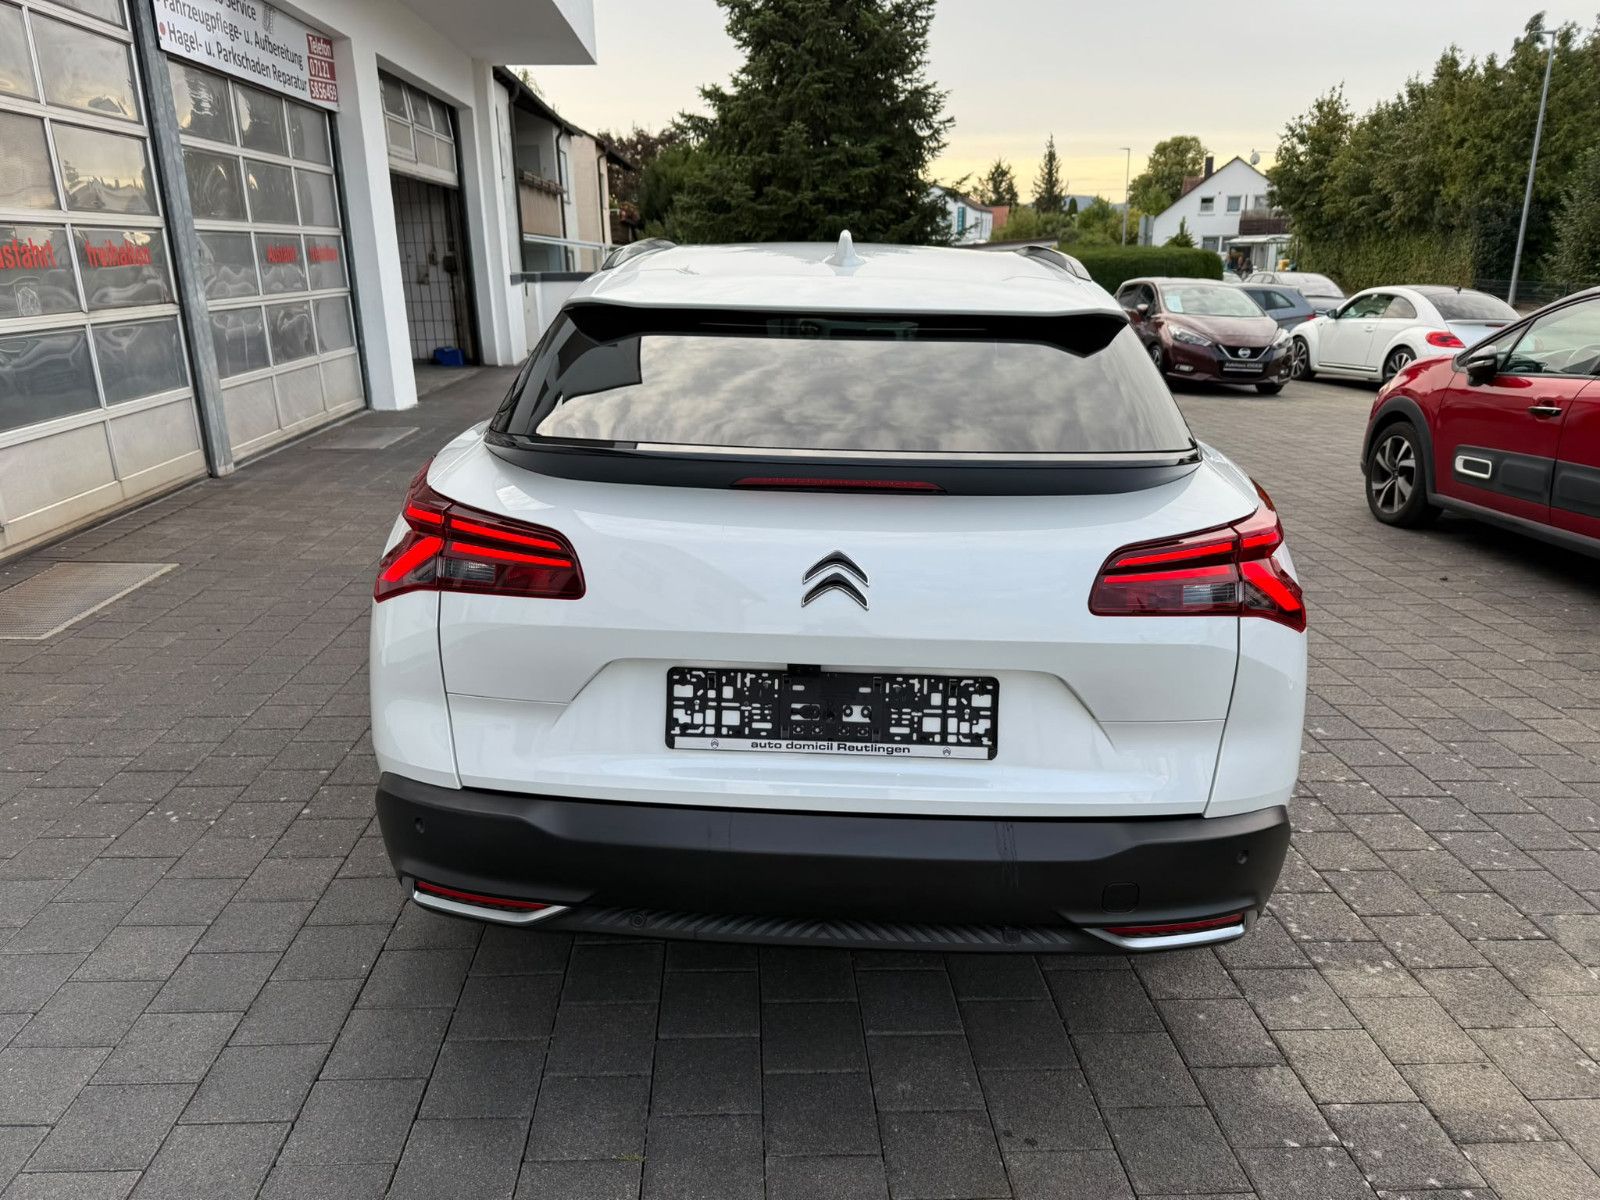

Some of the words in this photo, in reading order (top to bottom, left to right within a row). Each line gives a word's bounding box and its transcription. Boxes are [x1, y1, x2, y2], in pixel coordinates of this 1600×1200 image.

[167, 21, 203, 53] Hagel-
[216, 41, 272, 78] Parkschaden
[271, 63, 308, 92] Reparatur
[254, 30, 304, 71] Aufbereitung
[307, 35, 333, 57] Telefon
[751, 741, 782, 749] auto
[786, 741, 833, 751] domicil
[837, 743, 911, 755] Reutlingen
